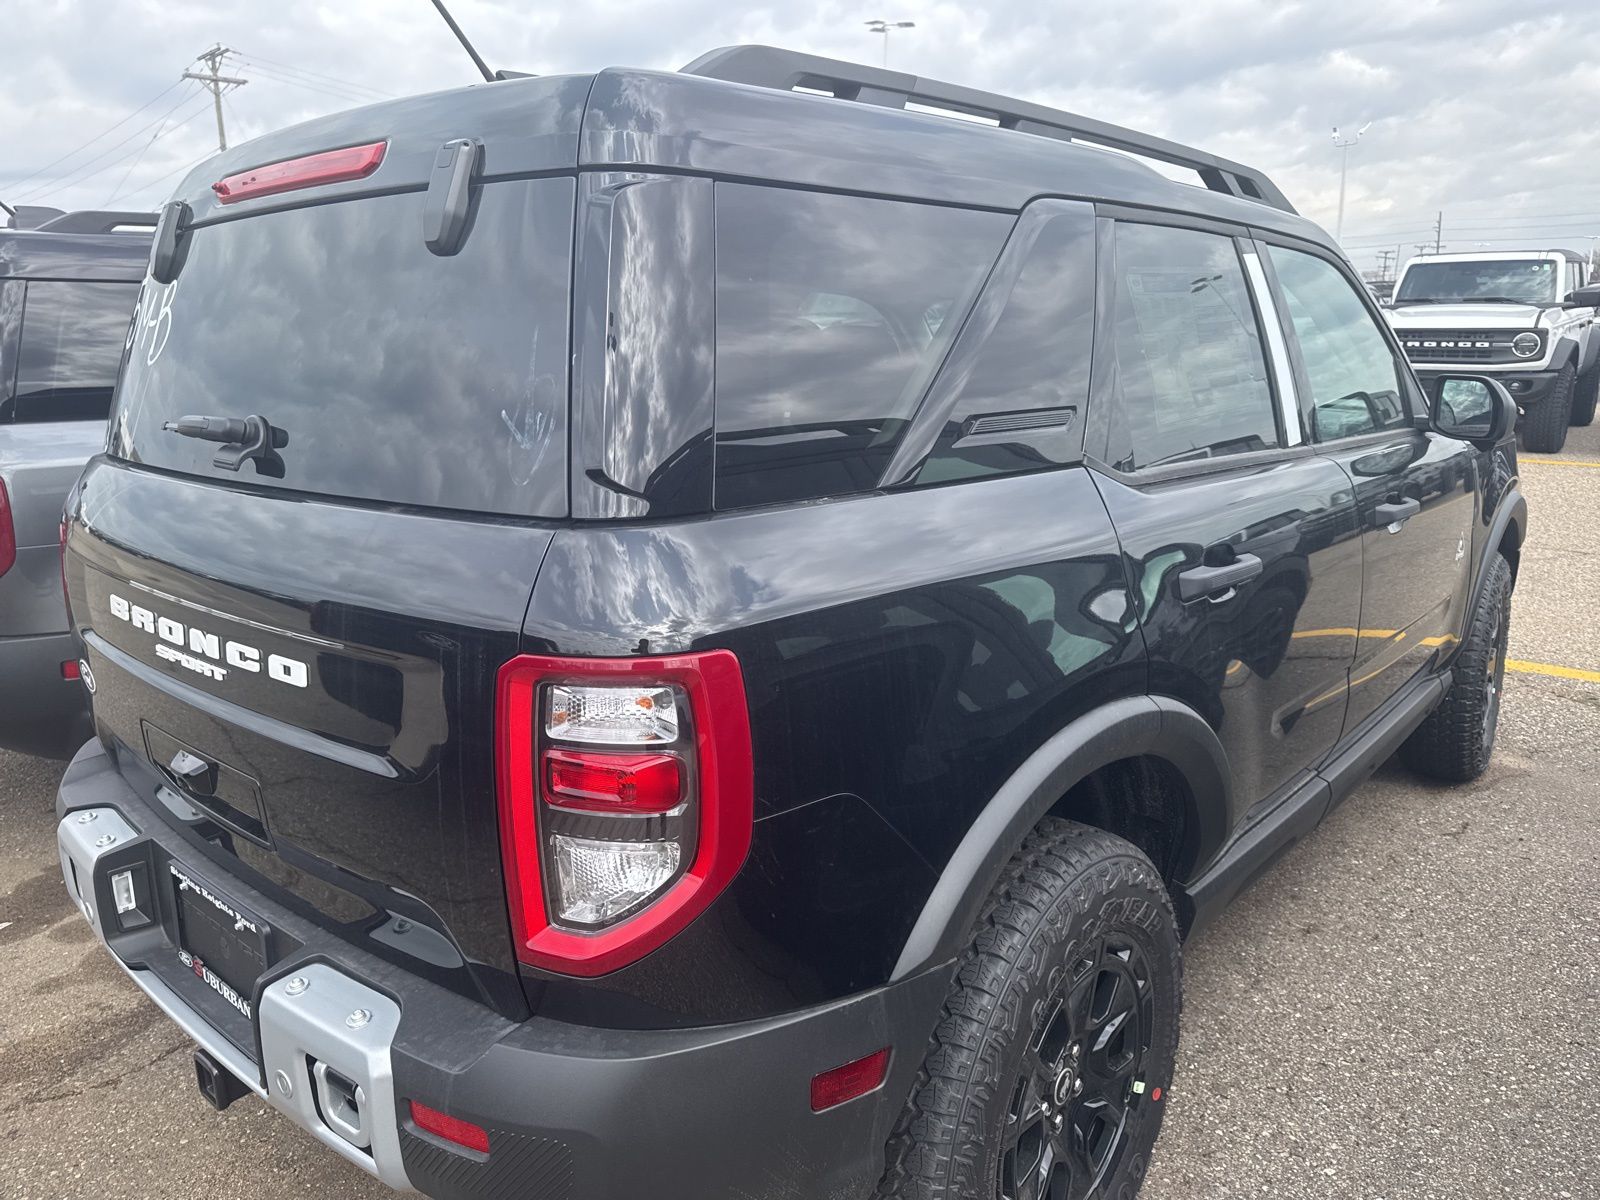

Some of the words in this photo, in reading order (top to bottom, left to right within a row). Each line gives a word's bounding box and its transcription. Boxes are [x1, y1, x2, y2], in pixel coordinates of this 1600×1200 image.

[1399, 340, 1490, 348] RONCO
[109, 593, 309, 688] BRONCO
[155, 643, 231, 681] SPORT
[192, 956, 252, 1020] SUBURBAN
